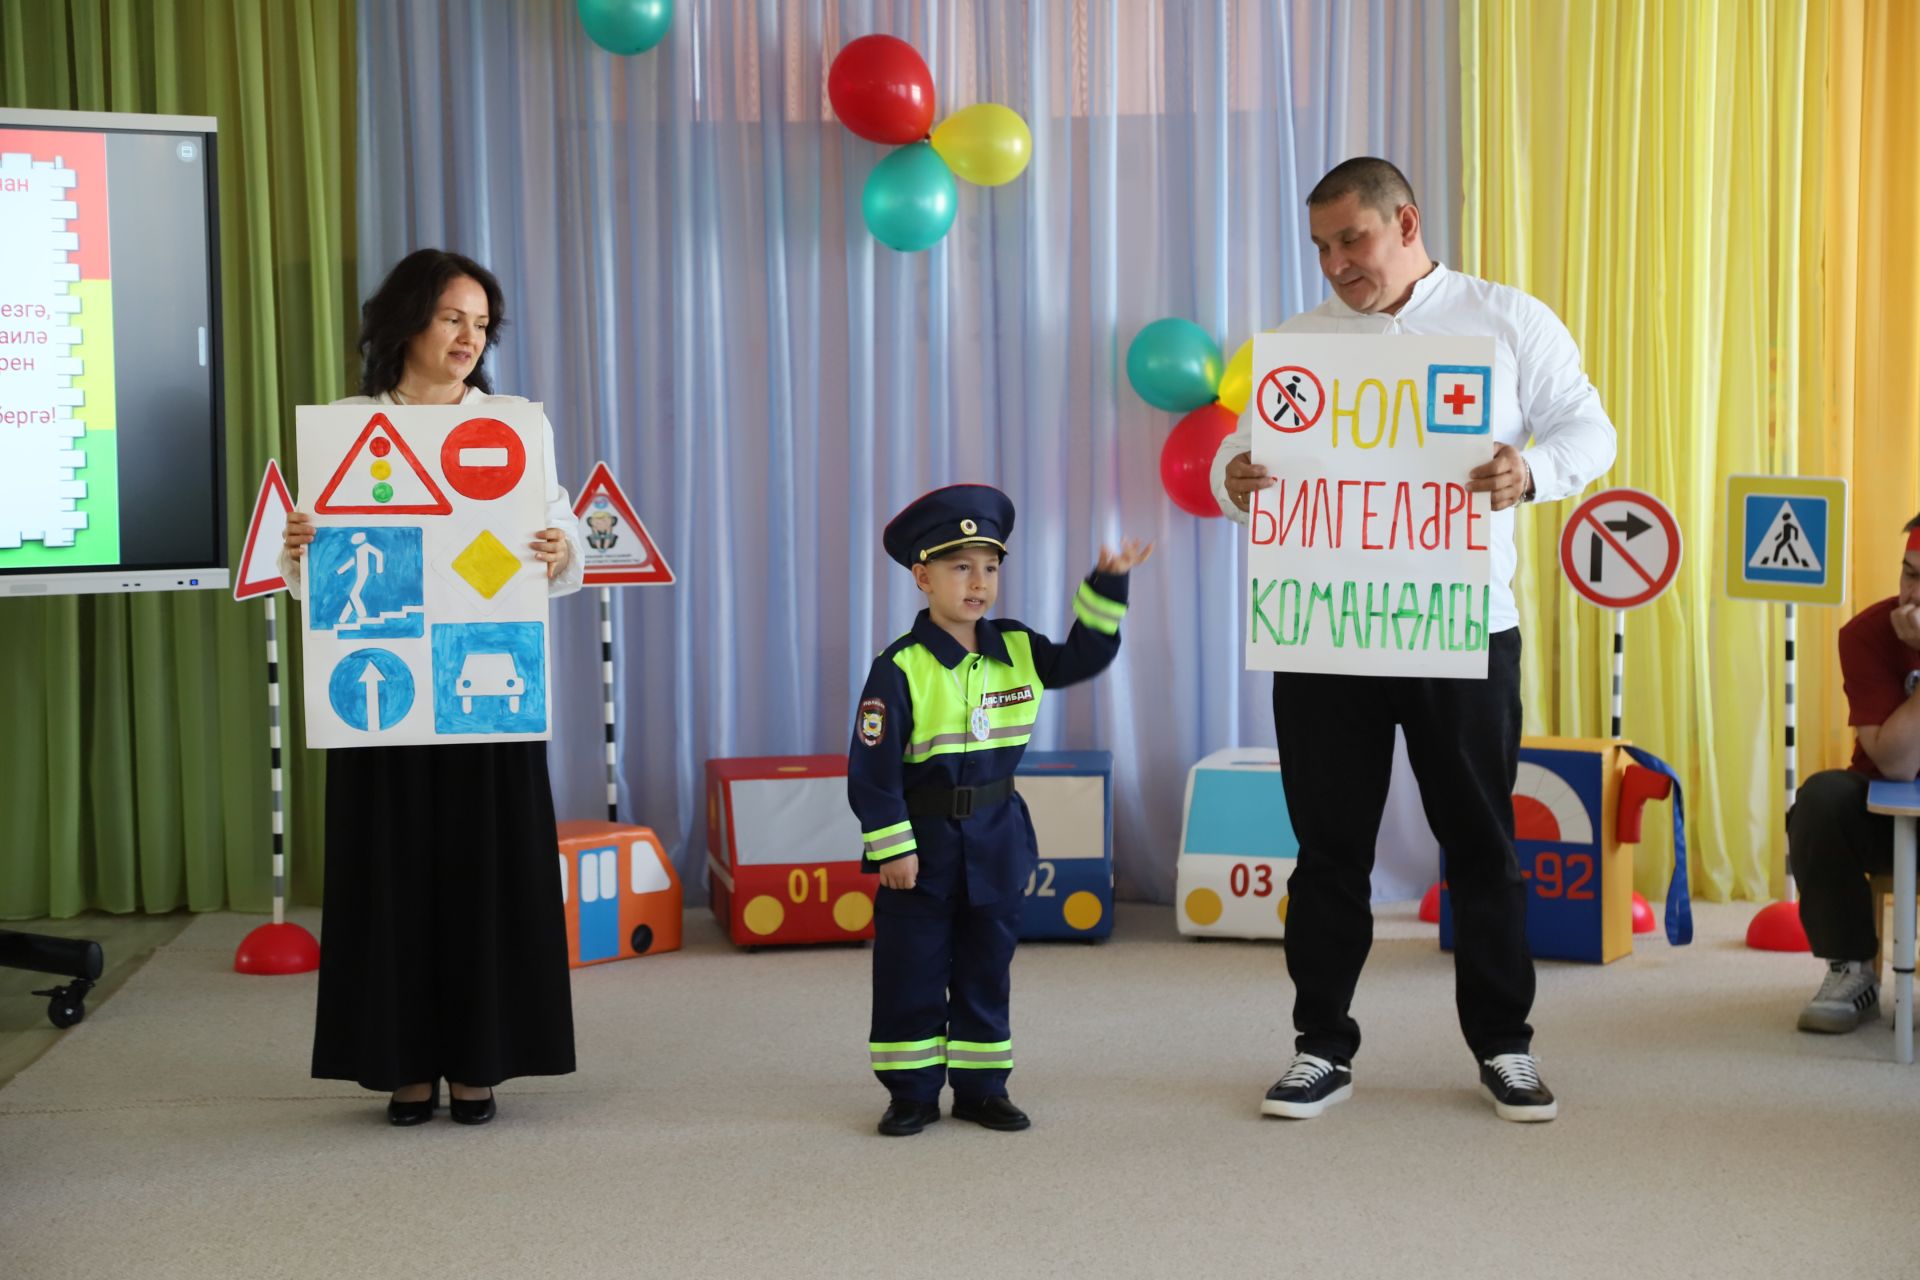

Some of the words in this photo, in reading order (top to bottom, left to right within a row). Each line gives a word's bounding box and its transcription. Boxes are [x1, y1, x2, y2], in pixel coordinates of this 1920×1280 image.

[1332, 378, 1424, 449] ЮЛ
[1252, 577, 1490, 651] КОМАНДАСЫ
[999, 689, 1033, 704] ГИБДД
[788, 867, 828, 904] 01
[1230, 862, 1273, 898] 03
[1520, 852, 1594, 899] -92
